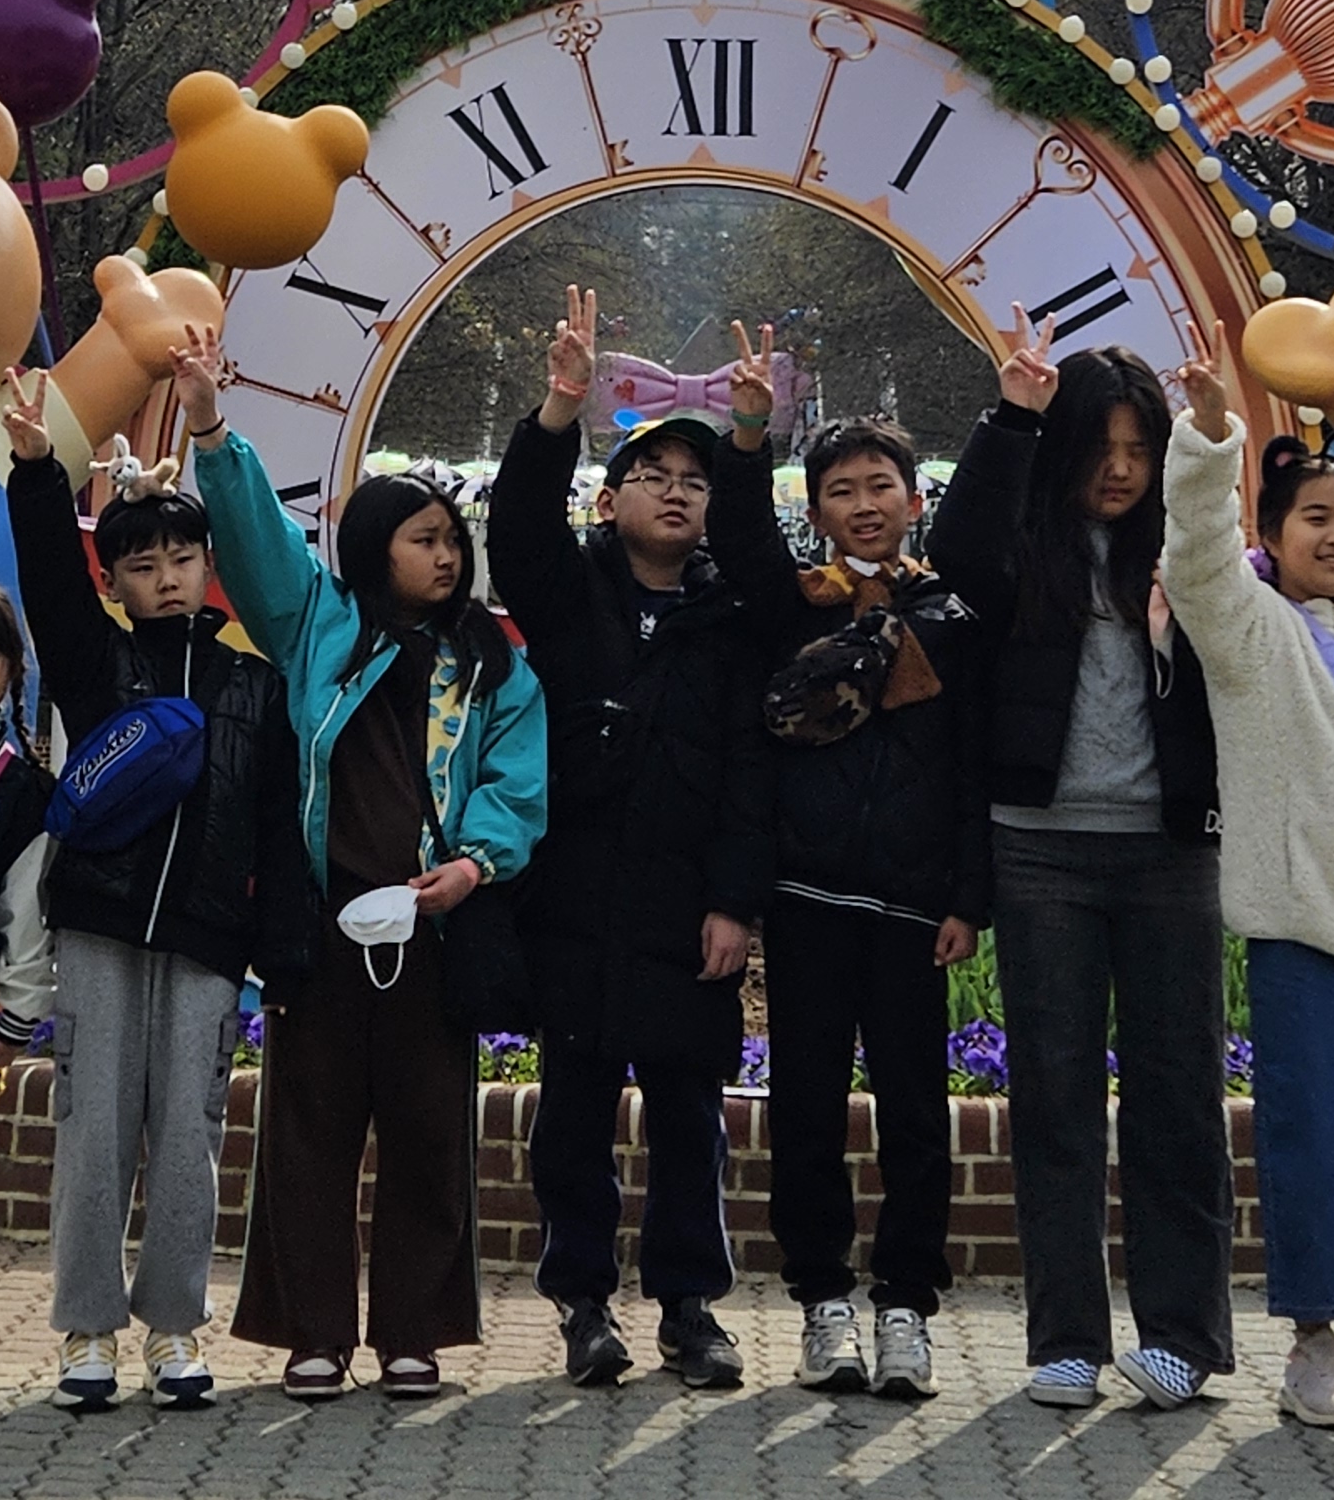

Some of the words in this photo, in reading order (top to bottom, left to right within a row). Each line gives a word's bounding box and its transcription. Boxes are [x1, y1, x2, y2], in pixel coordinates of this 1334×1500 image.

[662, 37, 758, 137] XII
[446, 81, 551, 200] XI
[888, 100, 955, 194] I
[282, 253, 391, 340] X
[1024, 262, 1134, 346] II
